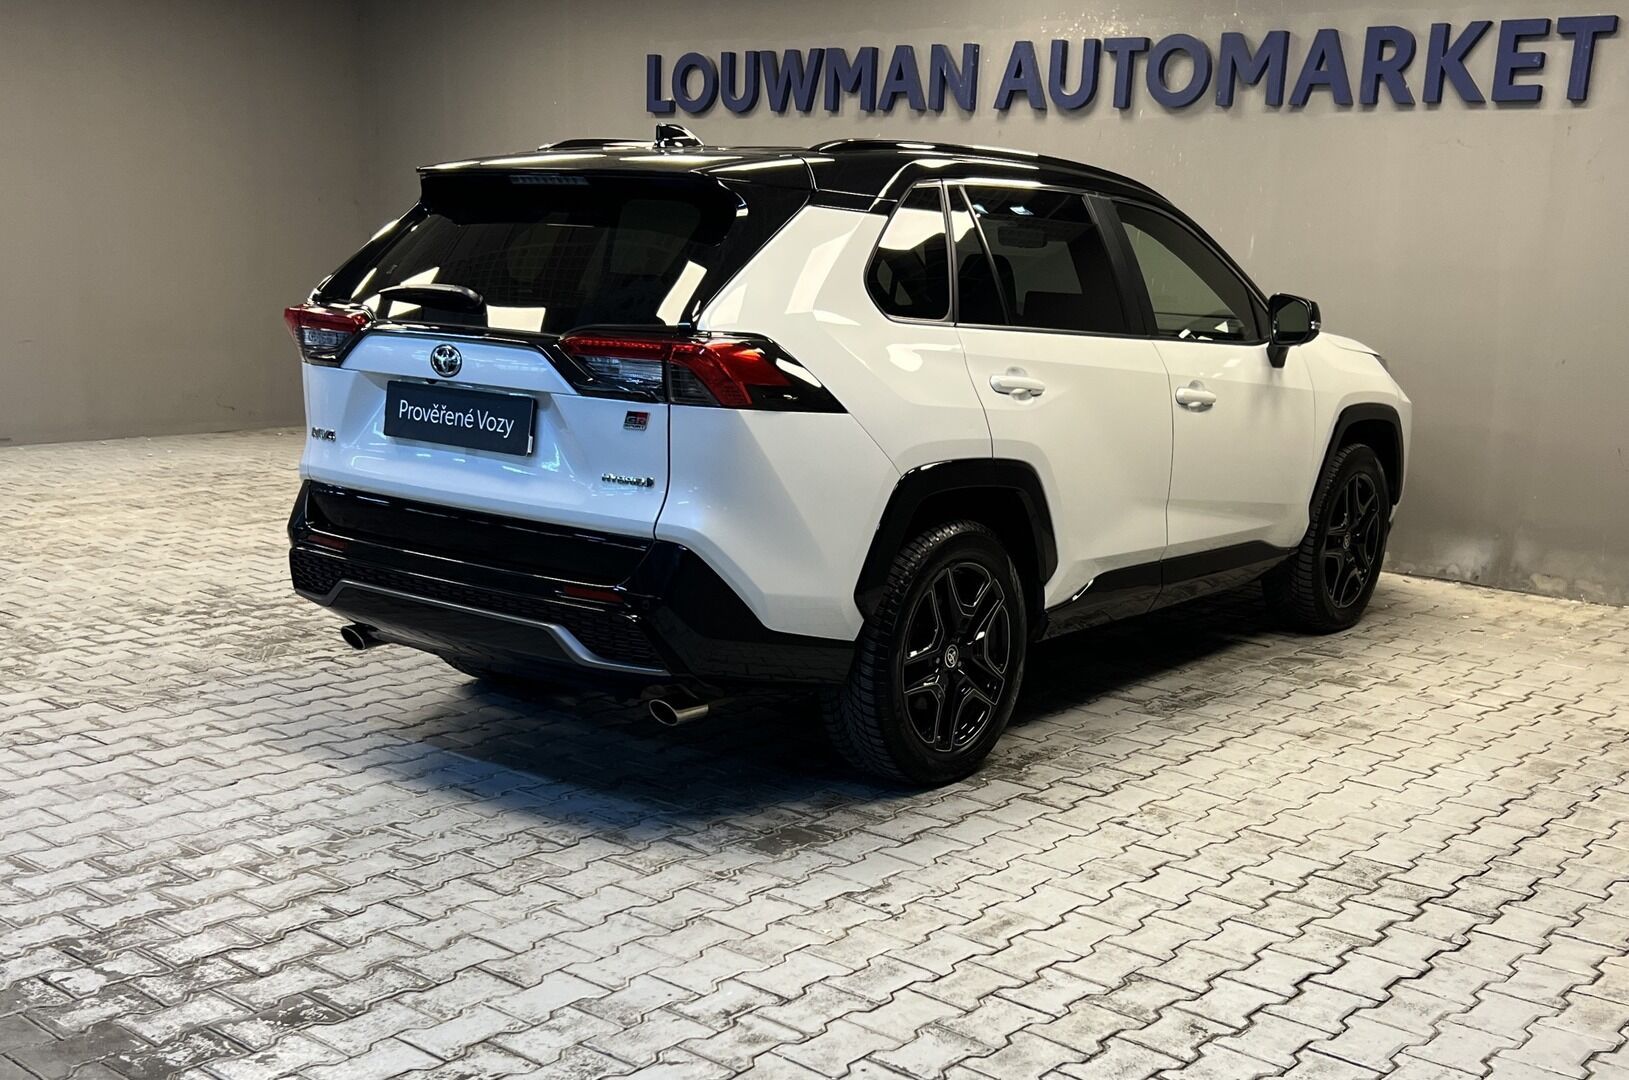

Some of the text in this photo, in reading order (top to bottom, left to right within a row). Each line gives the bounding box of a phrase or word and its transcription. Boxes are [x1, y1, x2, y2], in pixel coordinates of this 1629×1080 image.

[647, 15, 1618, 114] LOUWMAN AUTOMARKET
[399, 399, 514, 438] Prověřené Vozy
